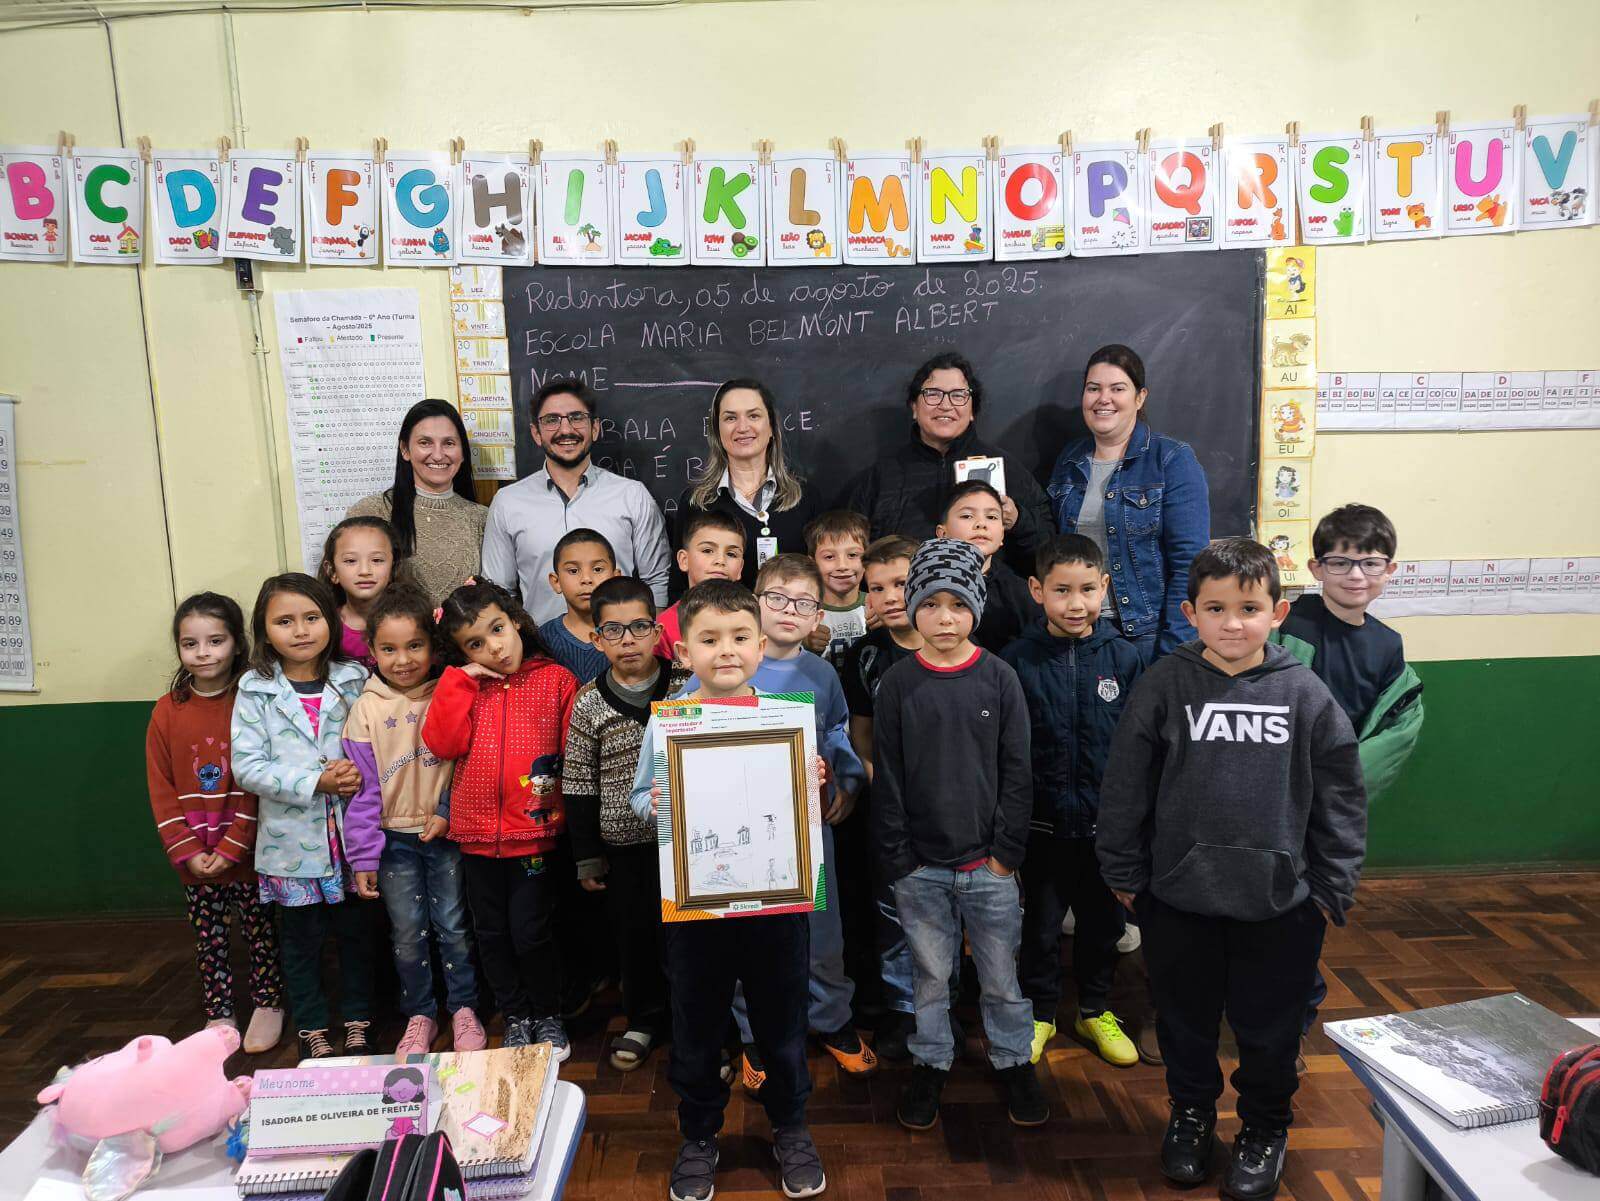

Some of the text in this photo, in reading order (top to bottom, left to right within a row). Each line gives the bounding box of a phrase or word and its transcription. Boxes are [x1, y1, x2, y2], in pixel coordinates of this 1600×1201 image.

[1532, 130, 1578, 190] V
[1386, 140, 1425, 197] T
[1454, 137, 1504, 197] U
[1309, 145, 1350, 204] S
[1154, 151, 1207, 215] Q
[1237, 153, 1278, 209] R
[7, 161, 55, 220] B
[84, 164, 131, 224] C
[930, 165, 977, 225] N
[1004, 162, 1058, 221] O
[1087, 160, 1128, 218] P
[165, 169, 217, 228] D
[241, 167, 283, 226] E
[326, 168, 361, 226] F
[395, 168, 450, 229] G
[471, 171, 523, 228] H
[564, 168, 585, 226] I
[636, 168, 668, 228] J
[703, 166, 751, 230] K
[788, 167, 821, 226] L
[848, 175, 909, 234] M
[1453, 203, 1475, 212] URSO
[1308, 215, 1328, 224] SAPO
[1152, 221, 1186, 231] QUADRO
[168, 237, 192, 245] DADO
[695, 283, 730, 307] 05
[740, 273, 775, 304] de
[789, 272, 895, 320] agosto
[913, 269, 947, 296] de
[455, 303, 468, 312] 20
[1284, 304, 1298, 315] AI
[526, 300, 998, 356] ESCOLA MARIA BELMONT ALBERT
[458, 340, 470, 350] 30
[1281, 372, 1298, 383] AU
[1335, 376, 1342, 385] B
[1416, 376, 1425, 385] C
[1498, 376, 1507, 385] D
[1582, 374, 1590, 383] F
[1464, 391, 1477, 399] DA
[463, 411, 477, 421] 50
[1278, 444, 1295, 455] EU
[653, 445, 672, 478] É
[0, 505, 11, 515] 39
[1277, 508, 1290, 518] OI
[0, 528, 14, 538] 49
[3, 550, 16, 560] 59
[1406, 565, 1415, 573] M
[1486, 563, 1495, 571] N
[1567, 562, 1574, 570] P
[4, 572, 17, 582] 69
[1284, 572, 1296, 581] UI
[6, 593, 20, 603] 79
[8, 615, 21, 625] 89
[9, 637, 23, 647] 99
[1184, 702, 1290, 744] VANS
[259, 1077, 315, 1090] Meu nome
[262, 1104, 420, 1126] ISADORA DE OLIVEIRA DE FREITAS
